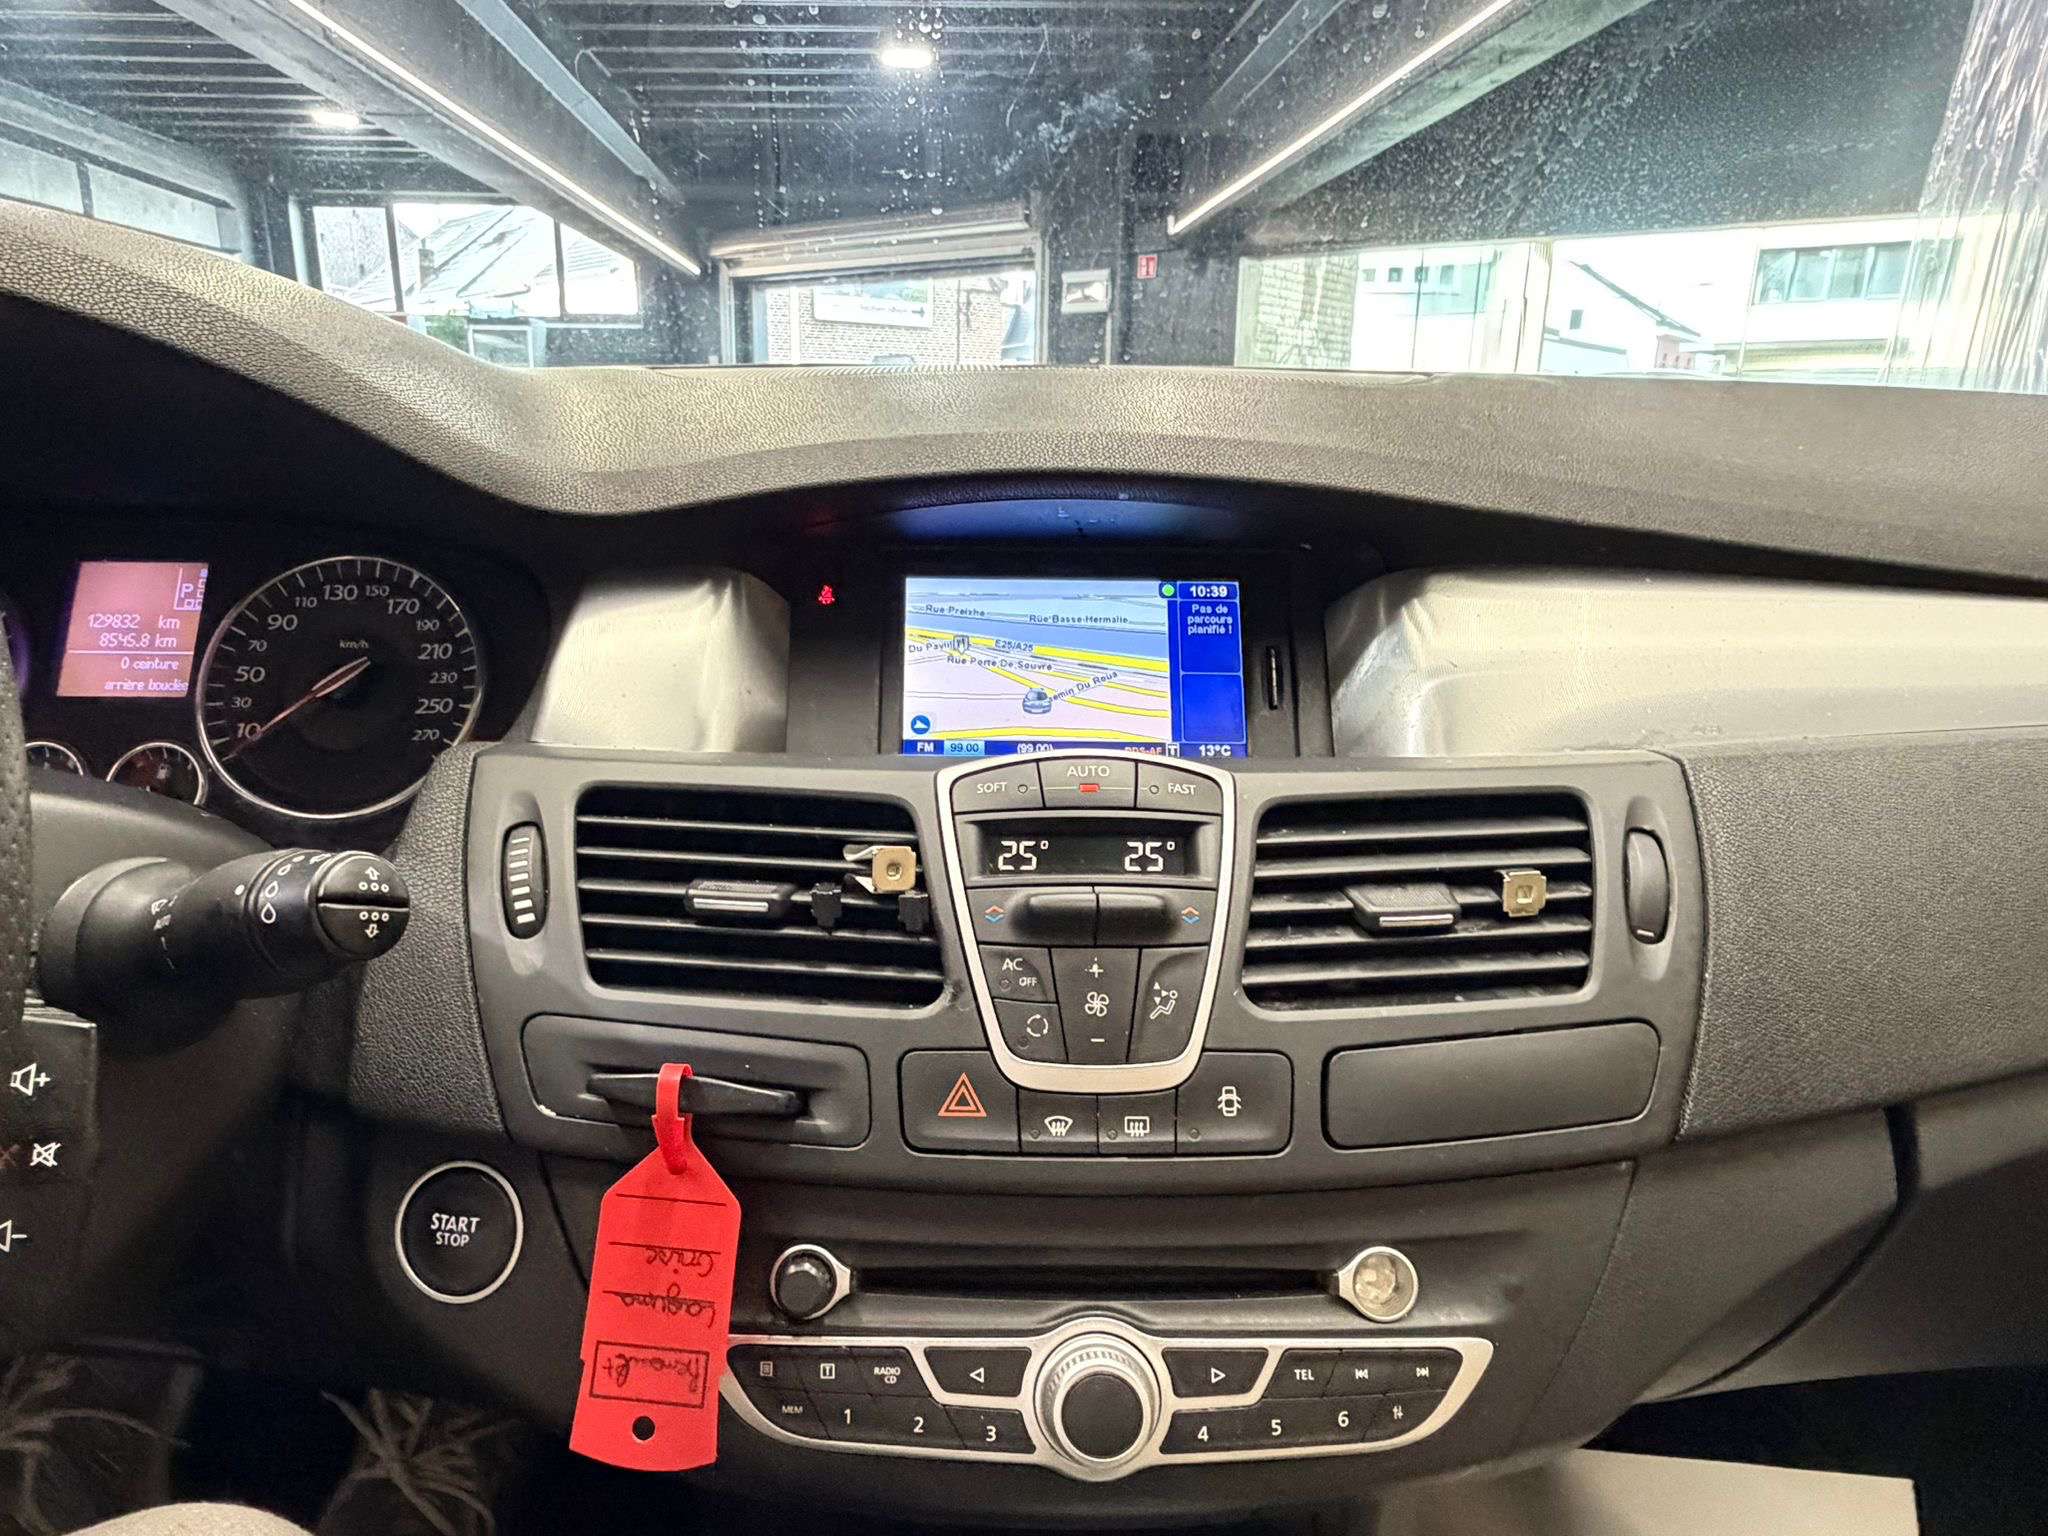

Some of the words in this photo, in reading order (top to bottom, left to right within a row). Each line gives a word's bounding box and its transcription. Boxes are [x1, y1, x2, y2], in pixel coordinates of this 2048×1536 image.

[322, 584, 358, 600] 130
[365, 584, 390, 597] 150
[1189, 585, 1228, 597] 10:39
[294, 596, 318, 608] 110
[387, 598, 420, 615] 170
[926, 604, 945, 614] Rue
[1191, 604, 1213, 614] Pas
[1215, 604, 1229, 614] de
[87, 614, 141, 629] 129832
[158, 615, 181, 629] km
[267, 614, 298, 631] 90
[416, 619, 440, 631] 190
[1029, 614, 1049, 624] Rue
[1187, 616, 1233, 626] parcours
[99, 633, 151, 648] 8545.8
[155, 634, 177, 648] km
[248, 640, 267, 652] 70
[339, 639, 369, 649] km/h
[995, 639, 1034, 651] E25/A25
[417, 643, 453, 660] 210
[908, 644, 923, 653] Du
[121, 656, 130, 669] 0
[133, 657, 179, 670] ceinture
[947, 655, 967, 665] Rue
[970, 656, 997, 667] Porte
[1000, 659, 1014, 668] De
[234, 666, 266, 683] 50
[429, 672, 458, 684] 230
[1076, 682, 1091, 692] Du
[231, 696, 252, 708] 30
[415, 698, 454, 715] 250
[236, 723, 261, 739] 10
[411, 729, 440, 741] 270
[916, 742, 934, 752] FM
[950, 743, 979, 753] 99.00
[1199, 744, 1231, 757] 13°C
[1066, 764, 1110, 777] AUTO
[976, 781, 1007, 794] SOFT
[1167, 783, 1196, 795] FAST
[997, 840, 1049, 871] 25°
[1124, 841, 1176, 872] 25°
[1001, 957, 1023, 971] AC
[1019, 976, 1038, 987] OFF
[430, 1212, 481, 1234] START
[435, 1231, 470, 1248] STOP
[618, 1283, 716, 1328] Laguna
[873, 1366, 901, 1376] RADIO
[1294, 1368, 1315, 1381] TEL
[884, 1375, 897, 1384] CD
[843, 1408, 851, 1424] 1
[1337, 1410, 1349, 1427] 6
[912, 1416, 924, 1433] 2
[1271, 1419, 1282, 1435] 5
[985, 1425, 996, 1442] 3
[1197, 1425, 1209, 1442] 4
